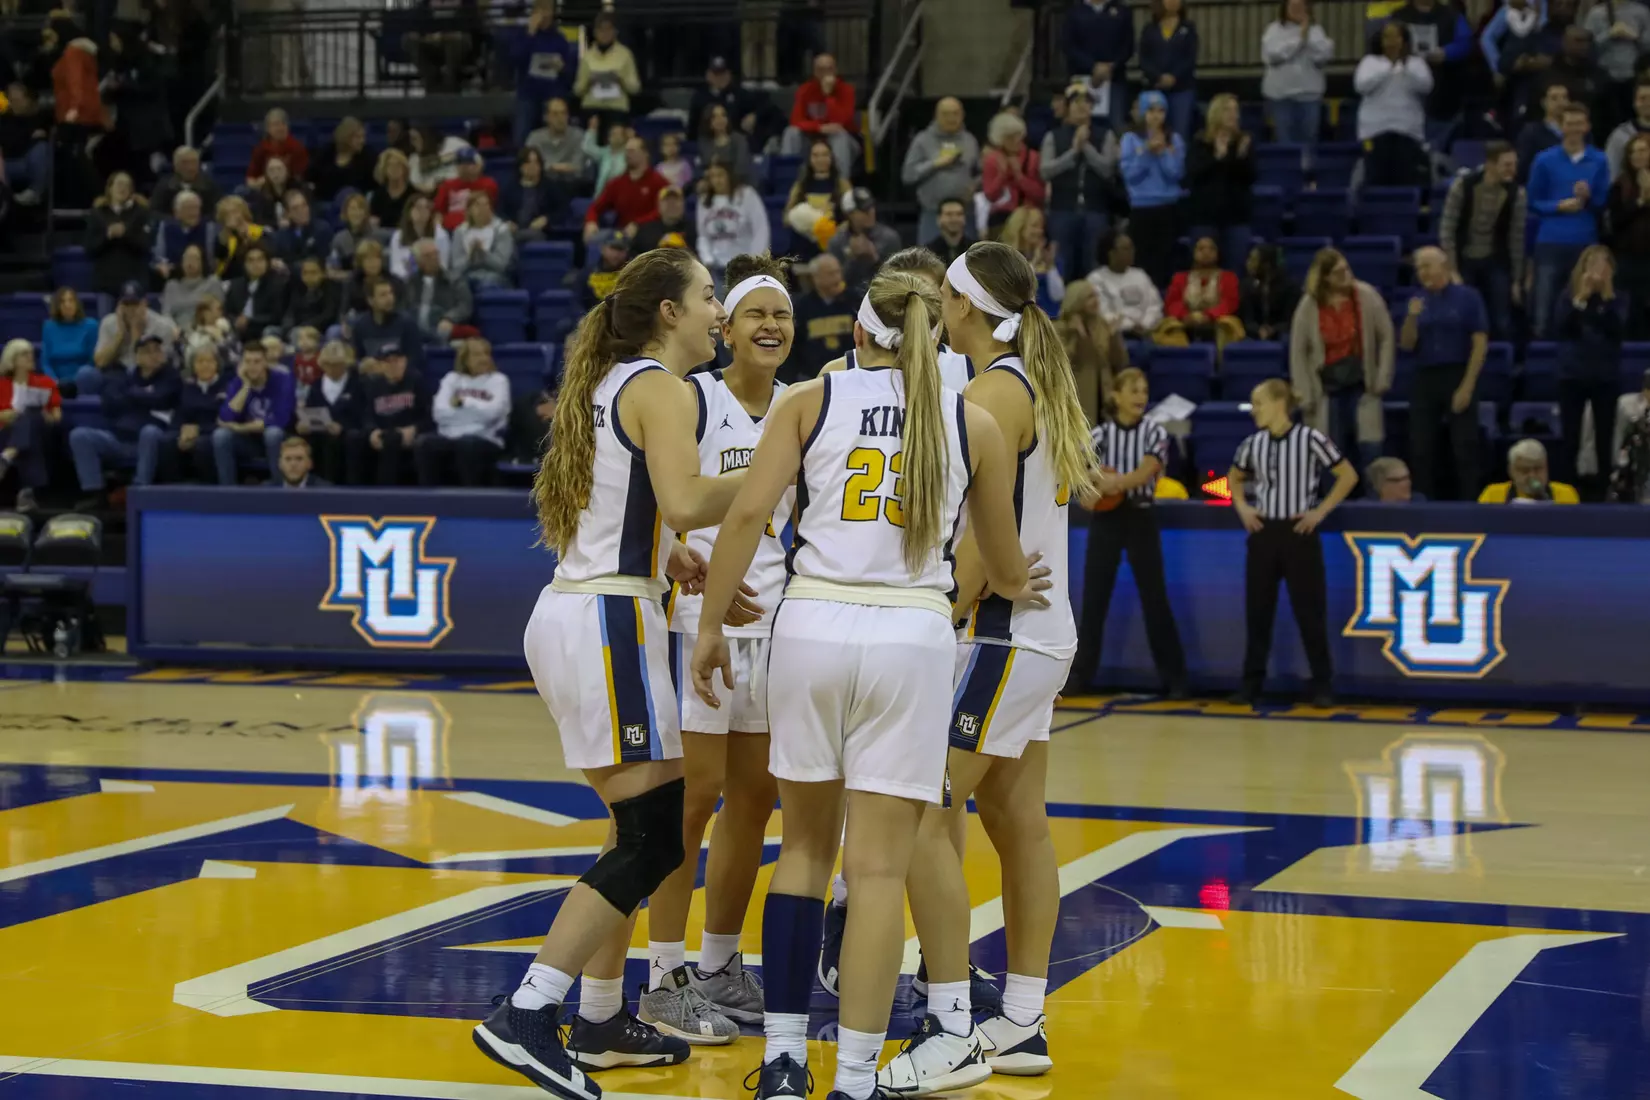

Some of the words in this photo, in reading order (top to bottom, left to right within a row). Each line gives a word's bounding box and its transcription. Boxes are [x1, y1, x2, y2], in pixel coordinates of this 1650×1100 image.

[859, 405, 906, 439] KIN
[334, 522, 443, 638] MU
[1360, 539, 1495, 669] MU
[624, 724, 646, 746] MU
[956, 713, 978, 736] MU
